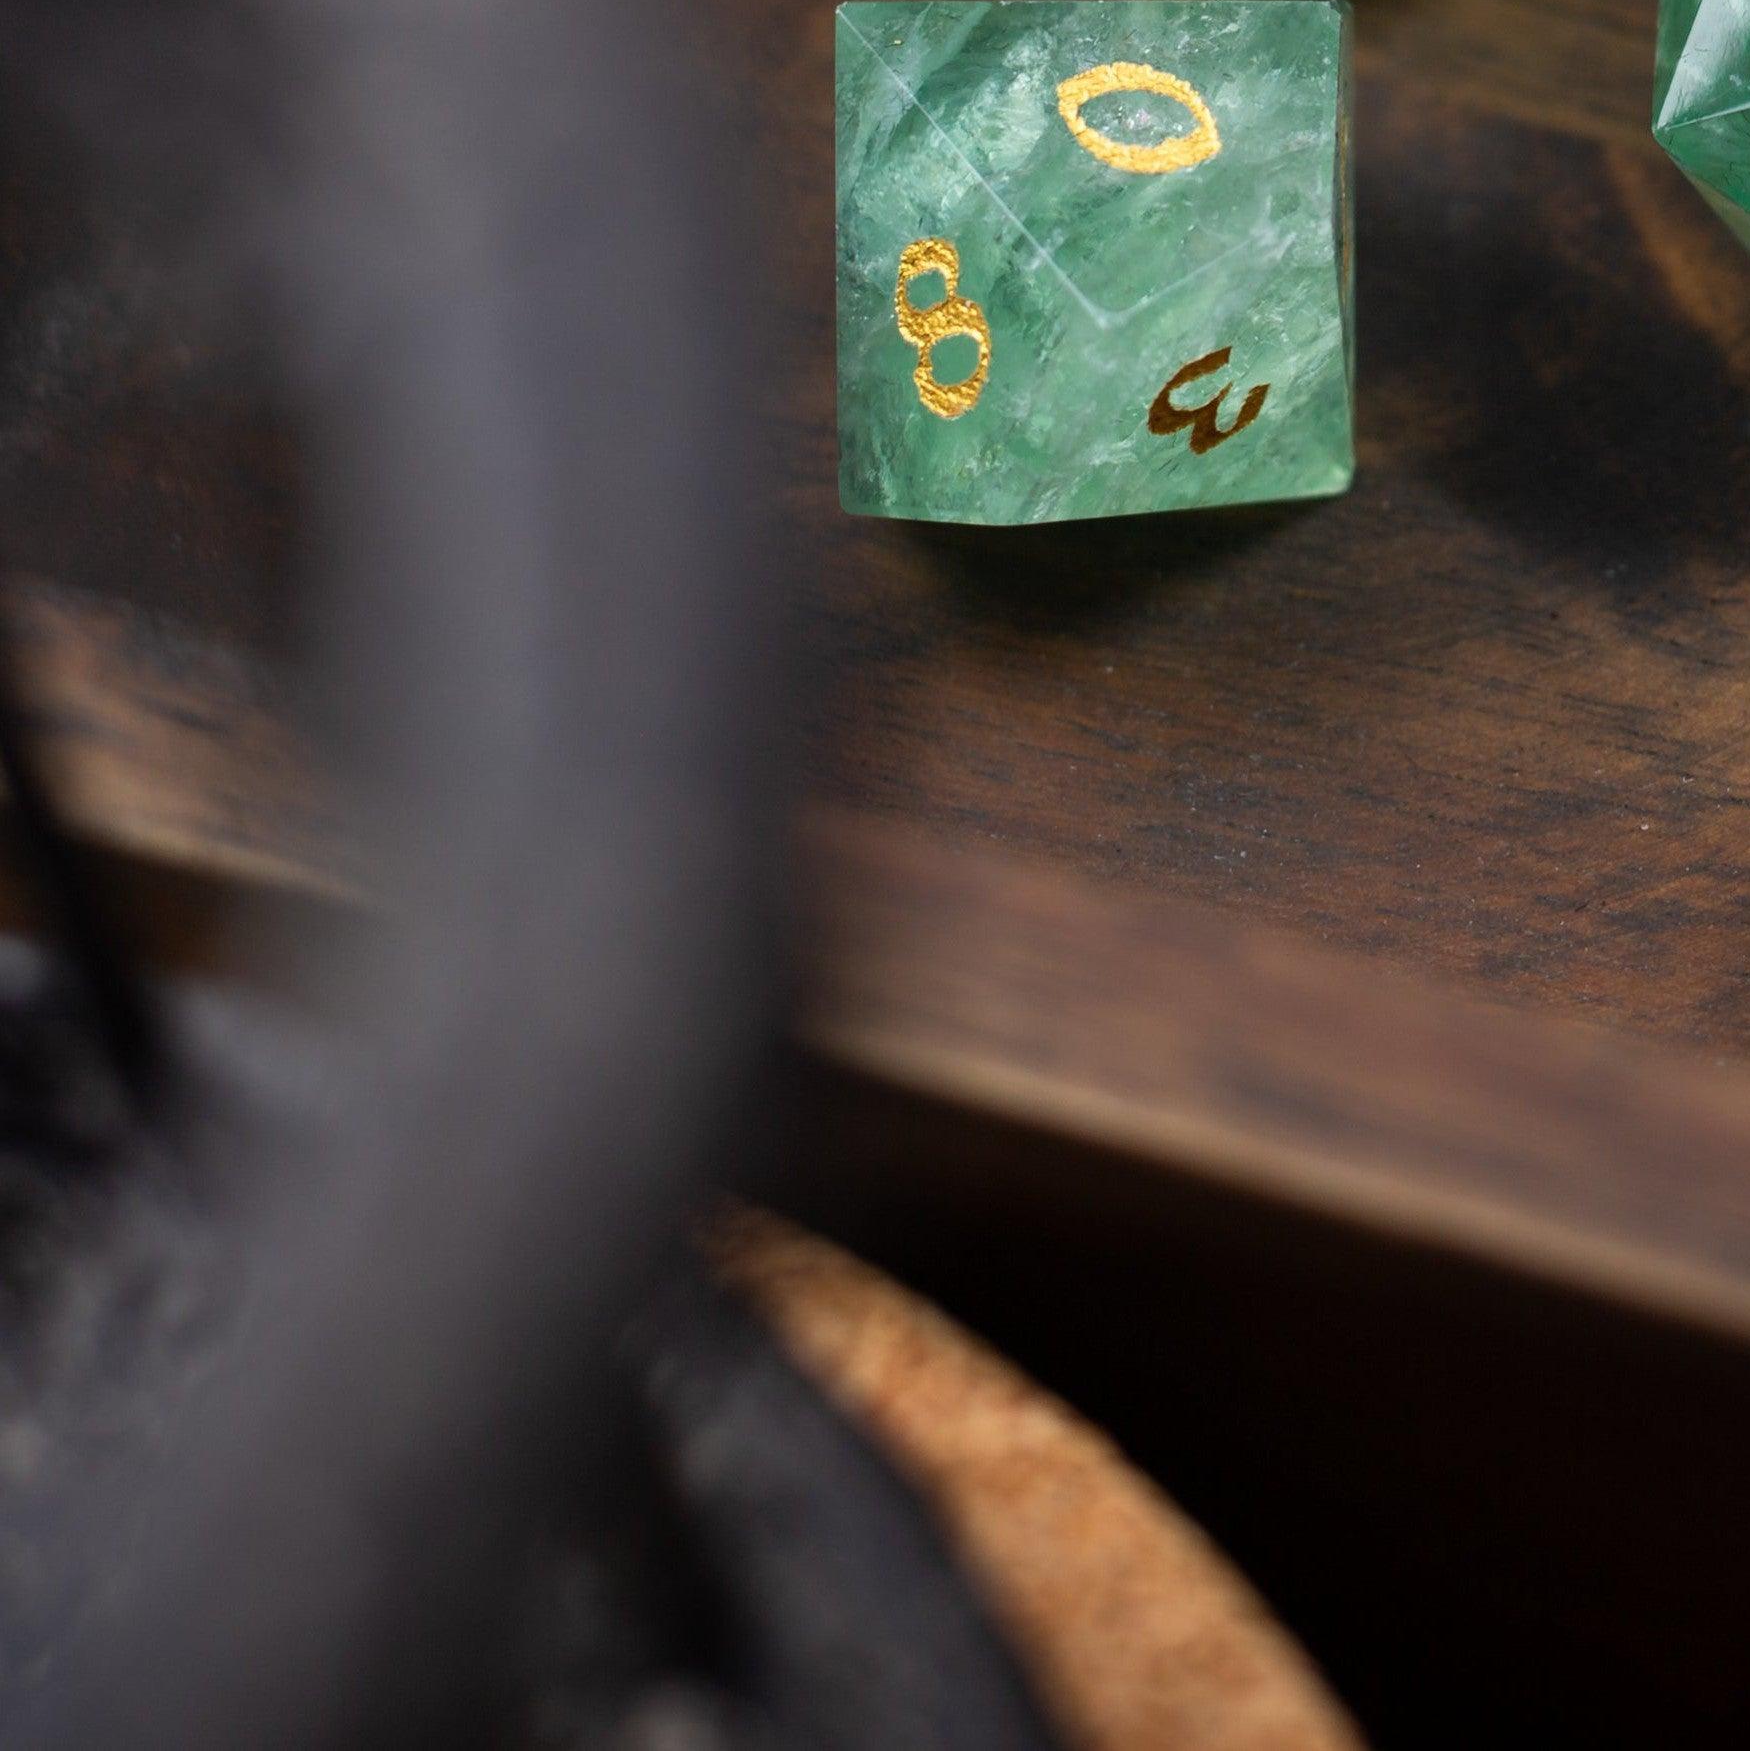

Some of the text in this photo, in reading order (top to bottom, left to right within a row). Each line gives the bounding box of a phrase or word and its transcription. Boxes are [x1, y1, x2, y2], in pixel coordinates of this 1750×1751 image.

[1056, 61, 1222, 174] 0
[895, 237, 991, 419] 8
[1147, 346, 1270, 455] 3
